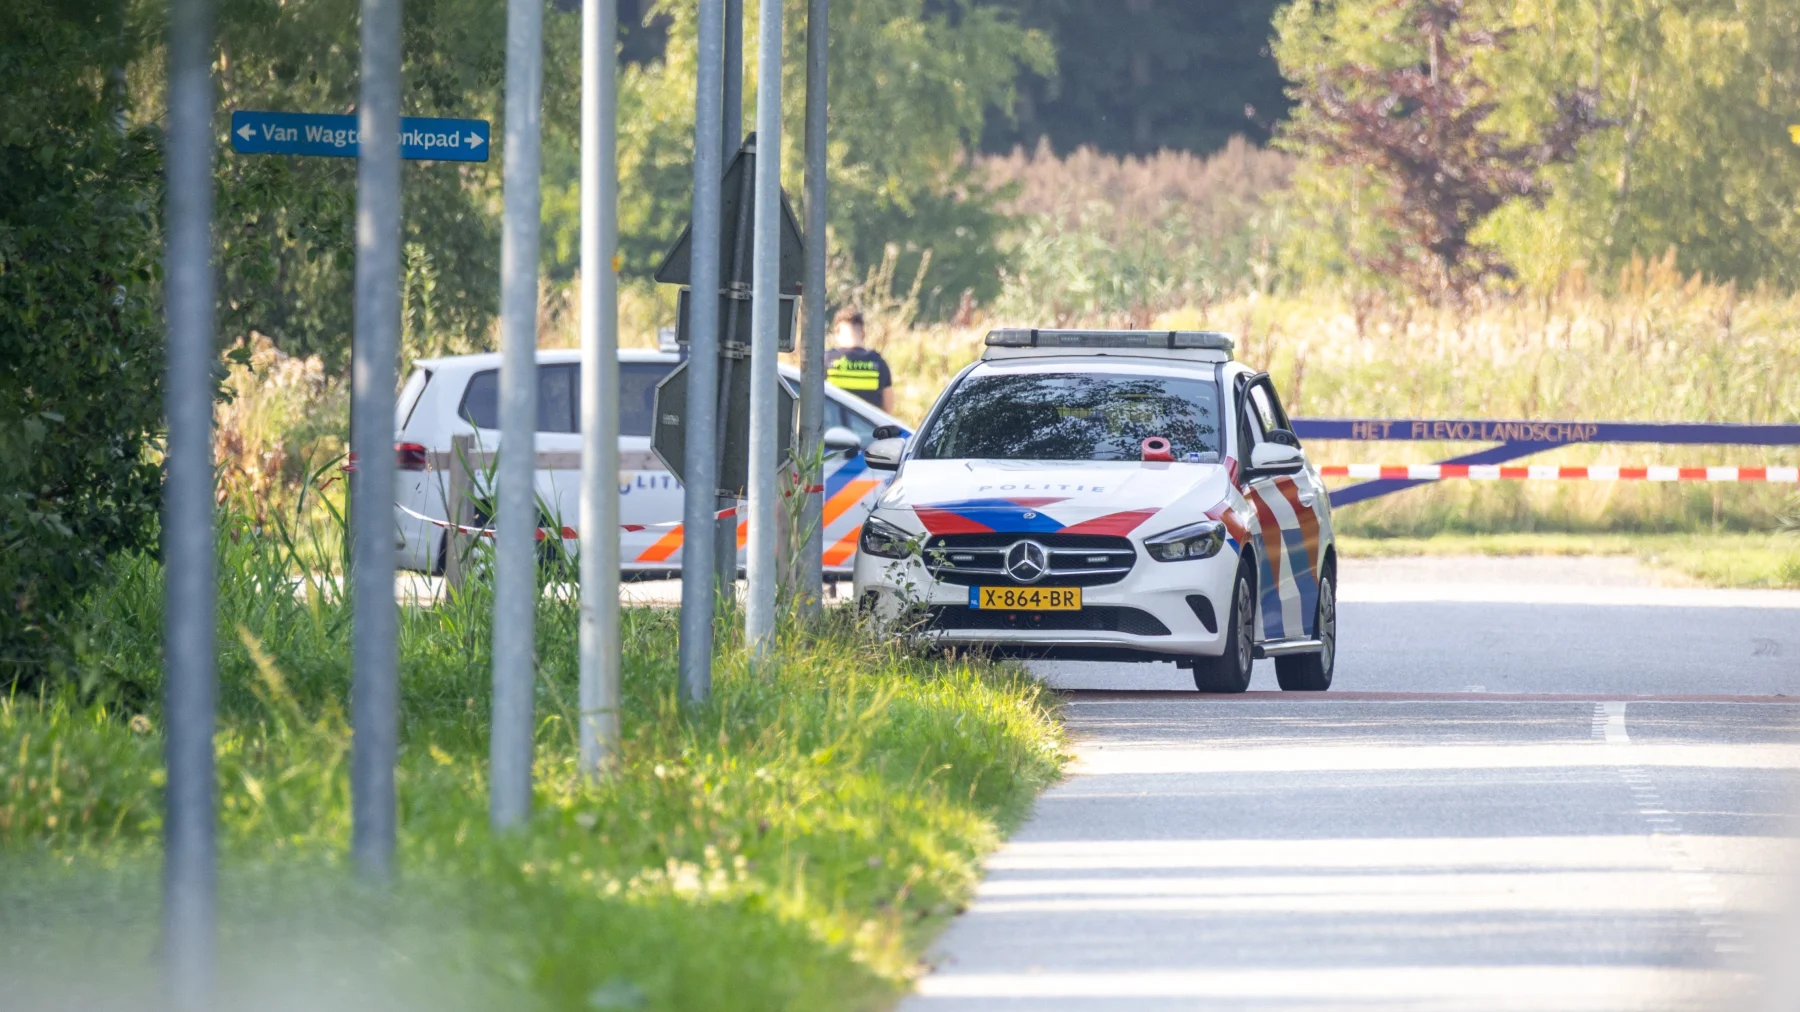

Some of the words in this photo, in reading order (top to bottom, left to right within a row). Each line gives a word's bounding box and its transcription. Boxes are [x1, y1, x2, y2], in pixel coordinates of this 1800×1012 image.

[262, 123, 298, 142] Van
[1351, 421, 1393, 440] HET
[978, 484, 1105, 493] POLITIE
[985, 590, 1075, 607] X-864-BR
